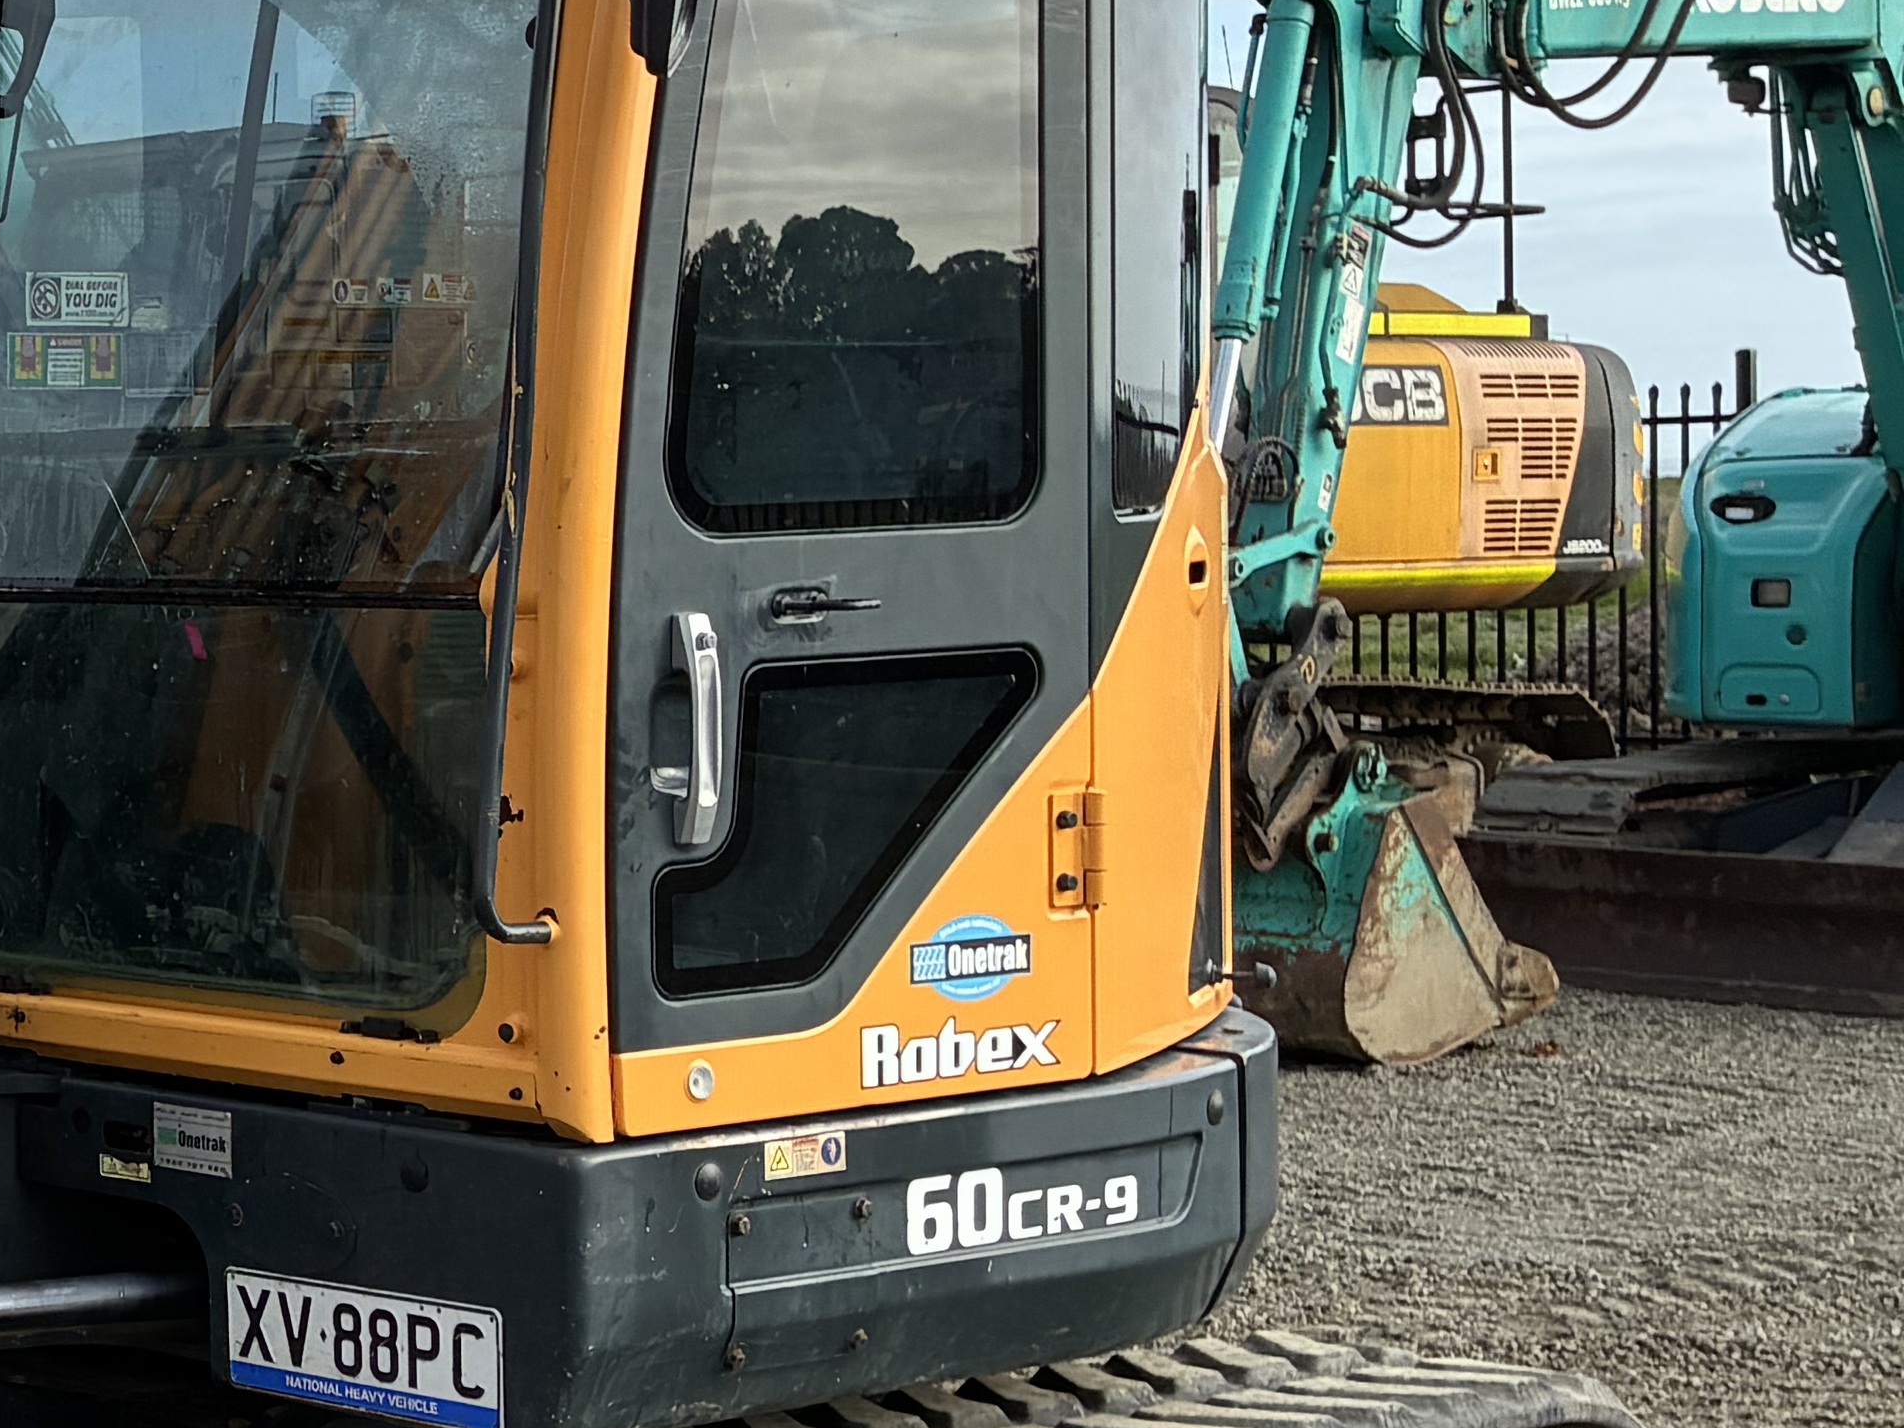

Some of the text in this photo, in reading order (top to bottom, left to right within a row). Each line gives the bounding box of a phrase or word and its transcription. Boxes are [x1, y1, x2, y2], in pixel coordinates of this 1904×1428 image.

[65, 293, 118, 308] YOU DIG
[948, 938, 1028, 976] Onetrak
[860, 1017, 1062, 1090] Robex
[178, 1130, 227, 1154] Onetrak
[906, 1167, 1139, 1255] 60CR-9
[285, 1374, 439, 1416] NATIONAL HEAVY VEHICLE
